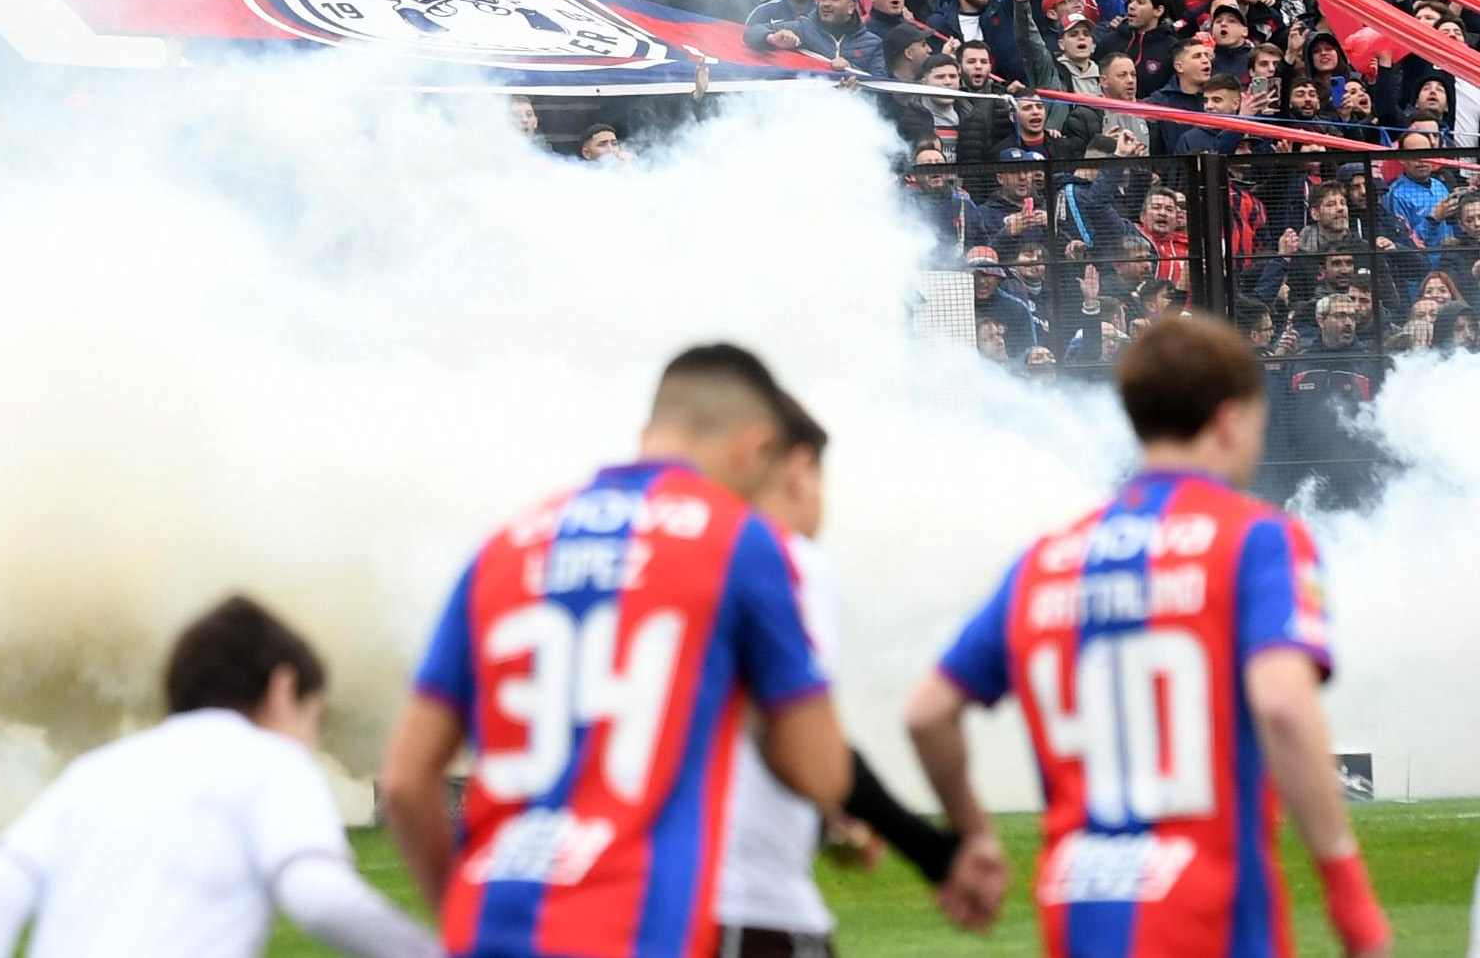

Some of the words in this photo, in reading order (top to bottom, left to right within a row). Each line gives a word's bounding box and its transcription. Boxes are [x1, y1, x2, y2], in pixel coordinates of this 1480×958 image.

[321, 1, 365, 20] 19
[478, 600, 689, 807] 34
[1026, 627, 1217, 828] 40
